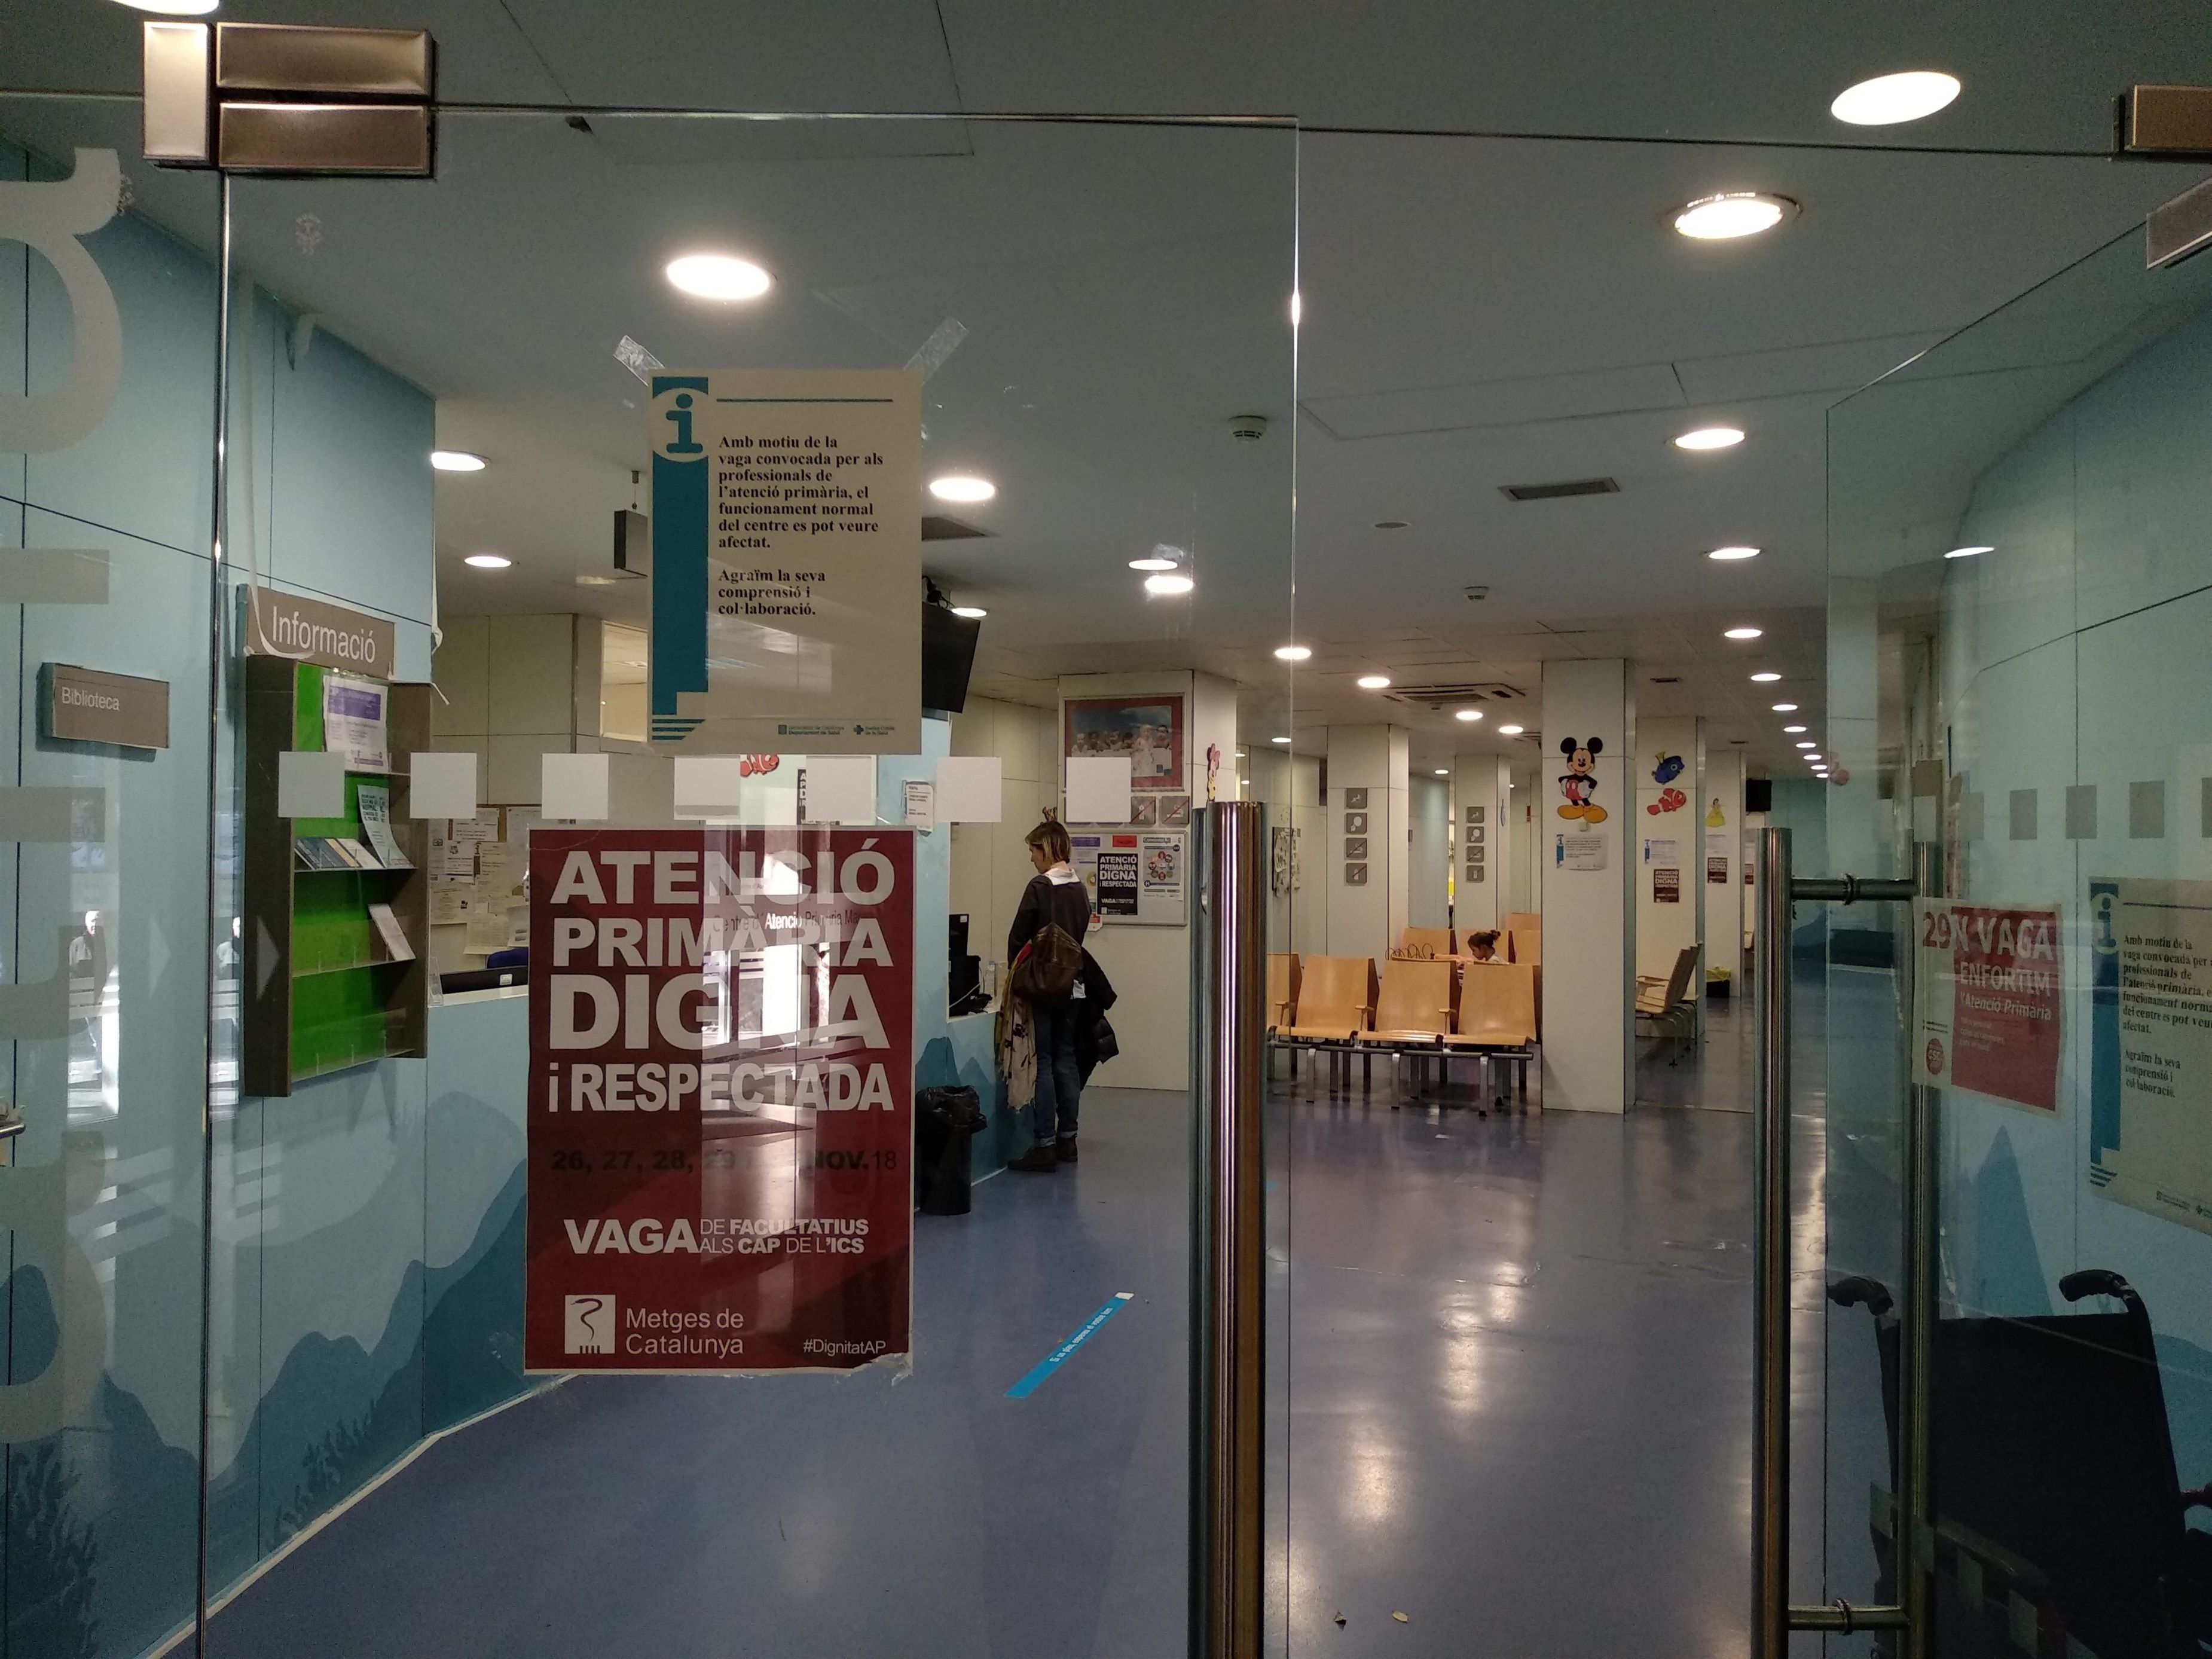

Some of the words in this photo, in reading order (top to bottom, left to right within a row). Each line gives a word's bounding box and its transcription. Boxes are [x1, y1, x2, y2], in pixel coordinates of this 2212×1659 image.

[719, 436, 753, 448] Amb
[759, 436, 799, 448] motiu
[805, 436, 821, 448] de
[826, 436, 838, 448] la
[719, 454, 751, 467] vaga
[756, 453, 831, 465] convocada
[836, 454, 860, 468] per
[864, 453, 883, 465] als
[719, 469, 811, 484] professionals
[816, 469, 832, 481] de
[719, 485, 780, 498] l'atenció
[784, 485, 853, 501] primària,
[857, 485, 869, 498] el
[719, 502, 817, 515] funcionament
[821, 503, 873, 515] normal
[719, 519, 740, 531] del
[744, 520, 789, 531] centre
[793, 521, 807, 531] es
[811, 520, 835, 535] pot
[839, 521, 879, 531] veure
[719, 536, 770, 548] afectat.
[718, 569, 773, 585] Agraïm
[778, 569, 790, 581] la
[795, 572, 826, 581] seva
[718, 586, 801, 601] comprensió
[806, 586, 810, 598] i
[718, 602, 815, 615] col·laboració.
[273, 606, 375, 663] Informació
[62, 686, 120, 711] Biblioteca
[1100, 855, 1136, 863] ATENCIÓ
[550, 838, 895, 905] ATENCIÓ
[1100, 870, 1136, 880] DIGNA
[553, 906, 894, 967] PRIMÀRIA
[1923, 912, 1969, 952] 29N
[1977, 917, 2054, 960] VAGA
[2124, 935, 2143, 946] Amb
[2145, 936, 2171, 949] motiu
[2173, 938, 2183, 949] de
[2123, 951, 2141, 961] vaga
[2143, 952, 2191, 965] convocada
[2193, 956, 2207, 968] per
[2124, 963, 2178, 979] professionals
[2180, 968, 2192, 980] de
[2004, 999, 2052, 1021] Primària
[2123, 990, 2178, 1008] funcionament
[2181, 1000, 2212, 1013] norma
[2123, 1005, 2134, 1016] del
[2136, 1008, 2161, 1021] centre
[2172, 1015, 2189, 1026] pot
[549, 1062, 559, 1112] i
[570, 1062, 895, 1112] RESPECTADA
[551, 1150, 592, 1173] 26,
[602, 1150, 643, 1173] 27,
[653, 1150, 693, 1173] 28,
[700, 1219, 725, 1235] DE
[729, 1218, 869, 1235] FACULTATIUS
[563, 1218, 700, 1254] VAGA
[699, 1237, 734, 1254] ALS
[738, 1237, 781, 1254] CAP
[786, 1237, 811, 1254] DE
[626, 1307, 710, 1334] Metges
[716, 1307, 744, 1328] de
[625, 1334, 744, 1359] Catalunya
[803, 1339, 886, 1356] #DignitatAP
